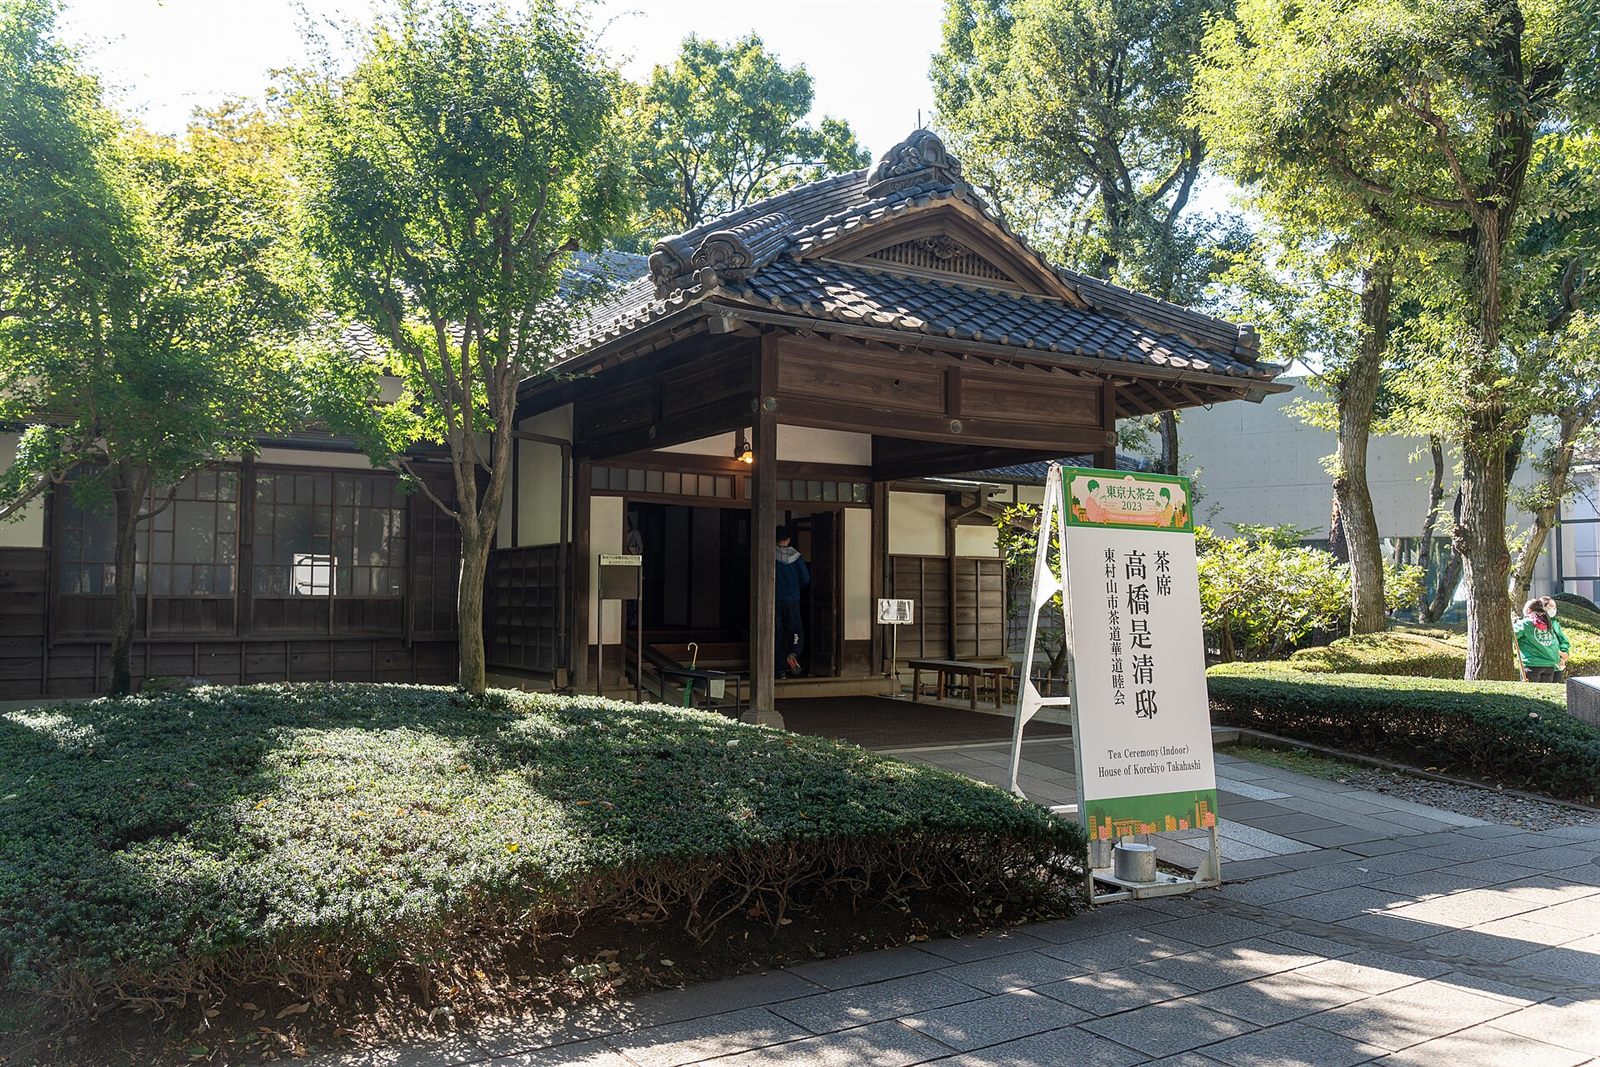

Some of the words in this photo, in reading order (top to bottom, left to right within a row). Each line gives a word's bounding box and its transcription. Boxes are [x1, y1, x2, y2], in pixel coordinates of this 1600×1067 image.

[1106, 485, 1155, 501] 東京大茶会
[1121, 501, 1143, 512] 2023
[1153, 550, 1172, 597] 茶席
[1103, 548, 1126, 706] 東村山市茶道華道睦会
[1124, 550, 1158, 720] 高橋是清邸
[1107, 750, 1122, 760] Tea
[1098, 766, 1122, 778] House
[1123, 765, 1132, 776] of
[1133, 763, 1165, 775] Korekiyo
[1166, 760, 1201, 772] Takahashi
